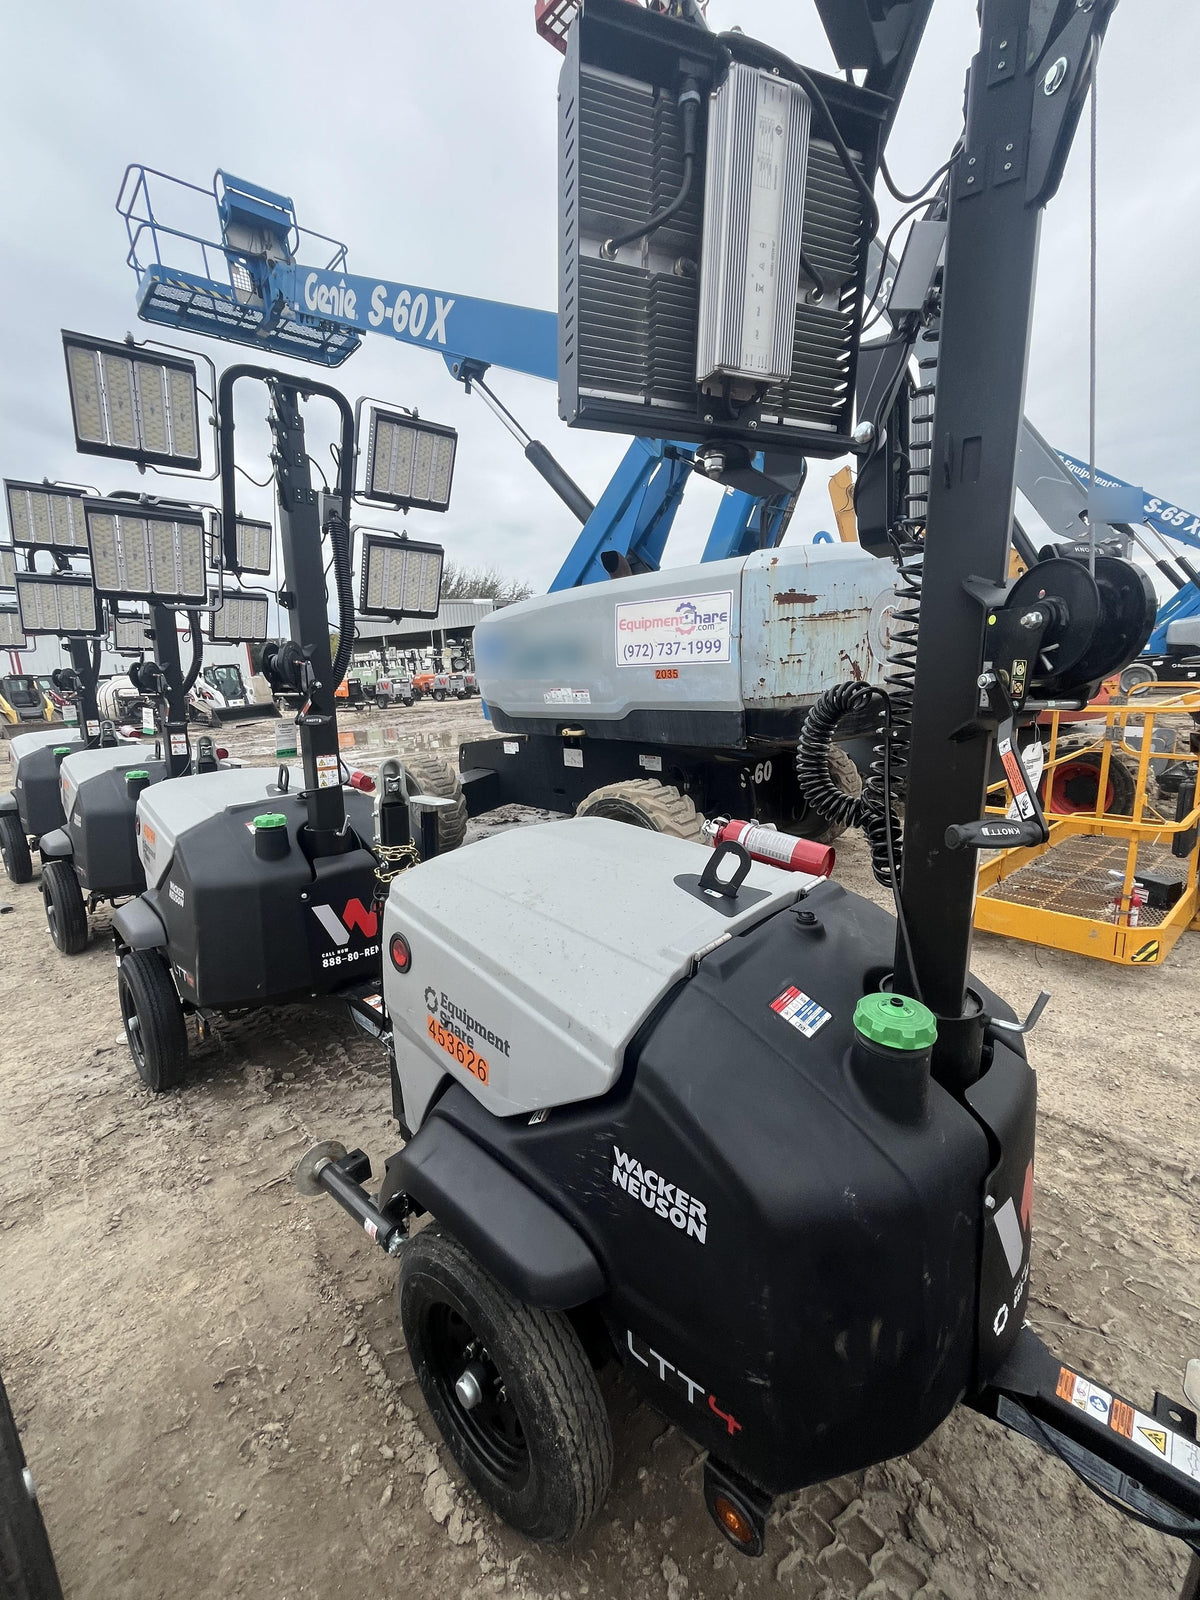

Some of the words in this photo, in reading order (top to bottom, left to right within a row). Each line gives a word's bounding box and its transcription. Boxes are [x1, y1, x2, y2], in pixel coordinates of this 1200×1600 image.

[304, 272, 357, 320] Genie
[367, 285, 428, 337] S-60
[425, 296, 455, 344] X
[1143, 498, 1190, 526] S-65
[623, 643, 654, 661] (972)
[657, 639, 722, 657] 737-1999
[655, 669, 678, 680] 2035
[990, 827, 1020, 836] KNOTT
[428, 1019, 487, 1082] 453626
[440, 991, 511, 1057] Equipment
[440, 1010, 475, 1050] Share
[611, 1164, 707, 1245] NEUSON
[613, 1144, 708, 1226] WACKER
[626, 1329, 743, 1436] LTT4
